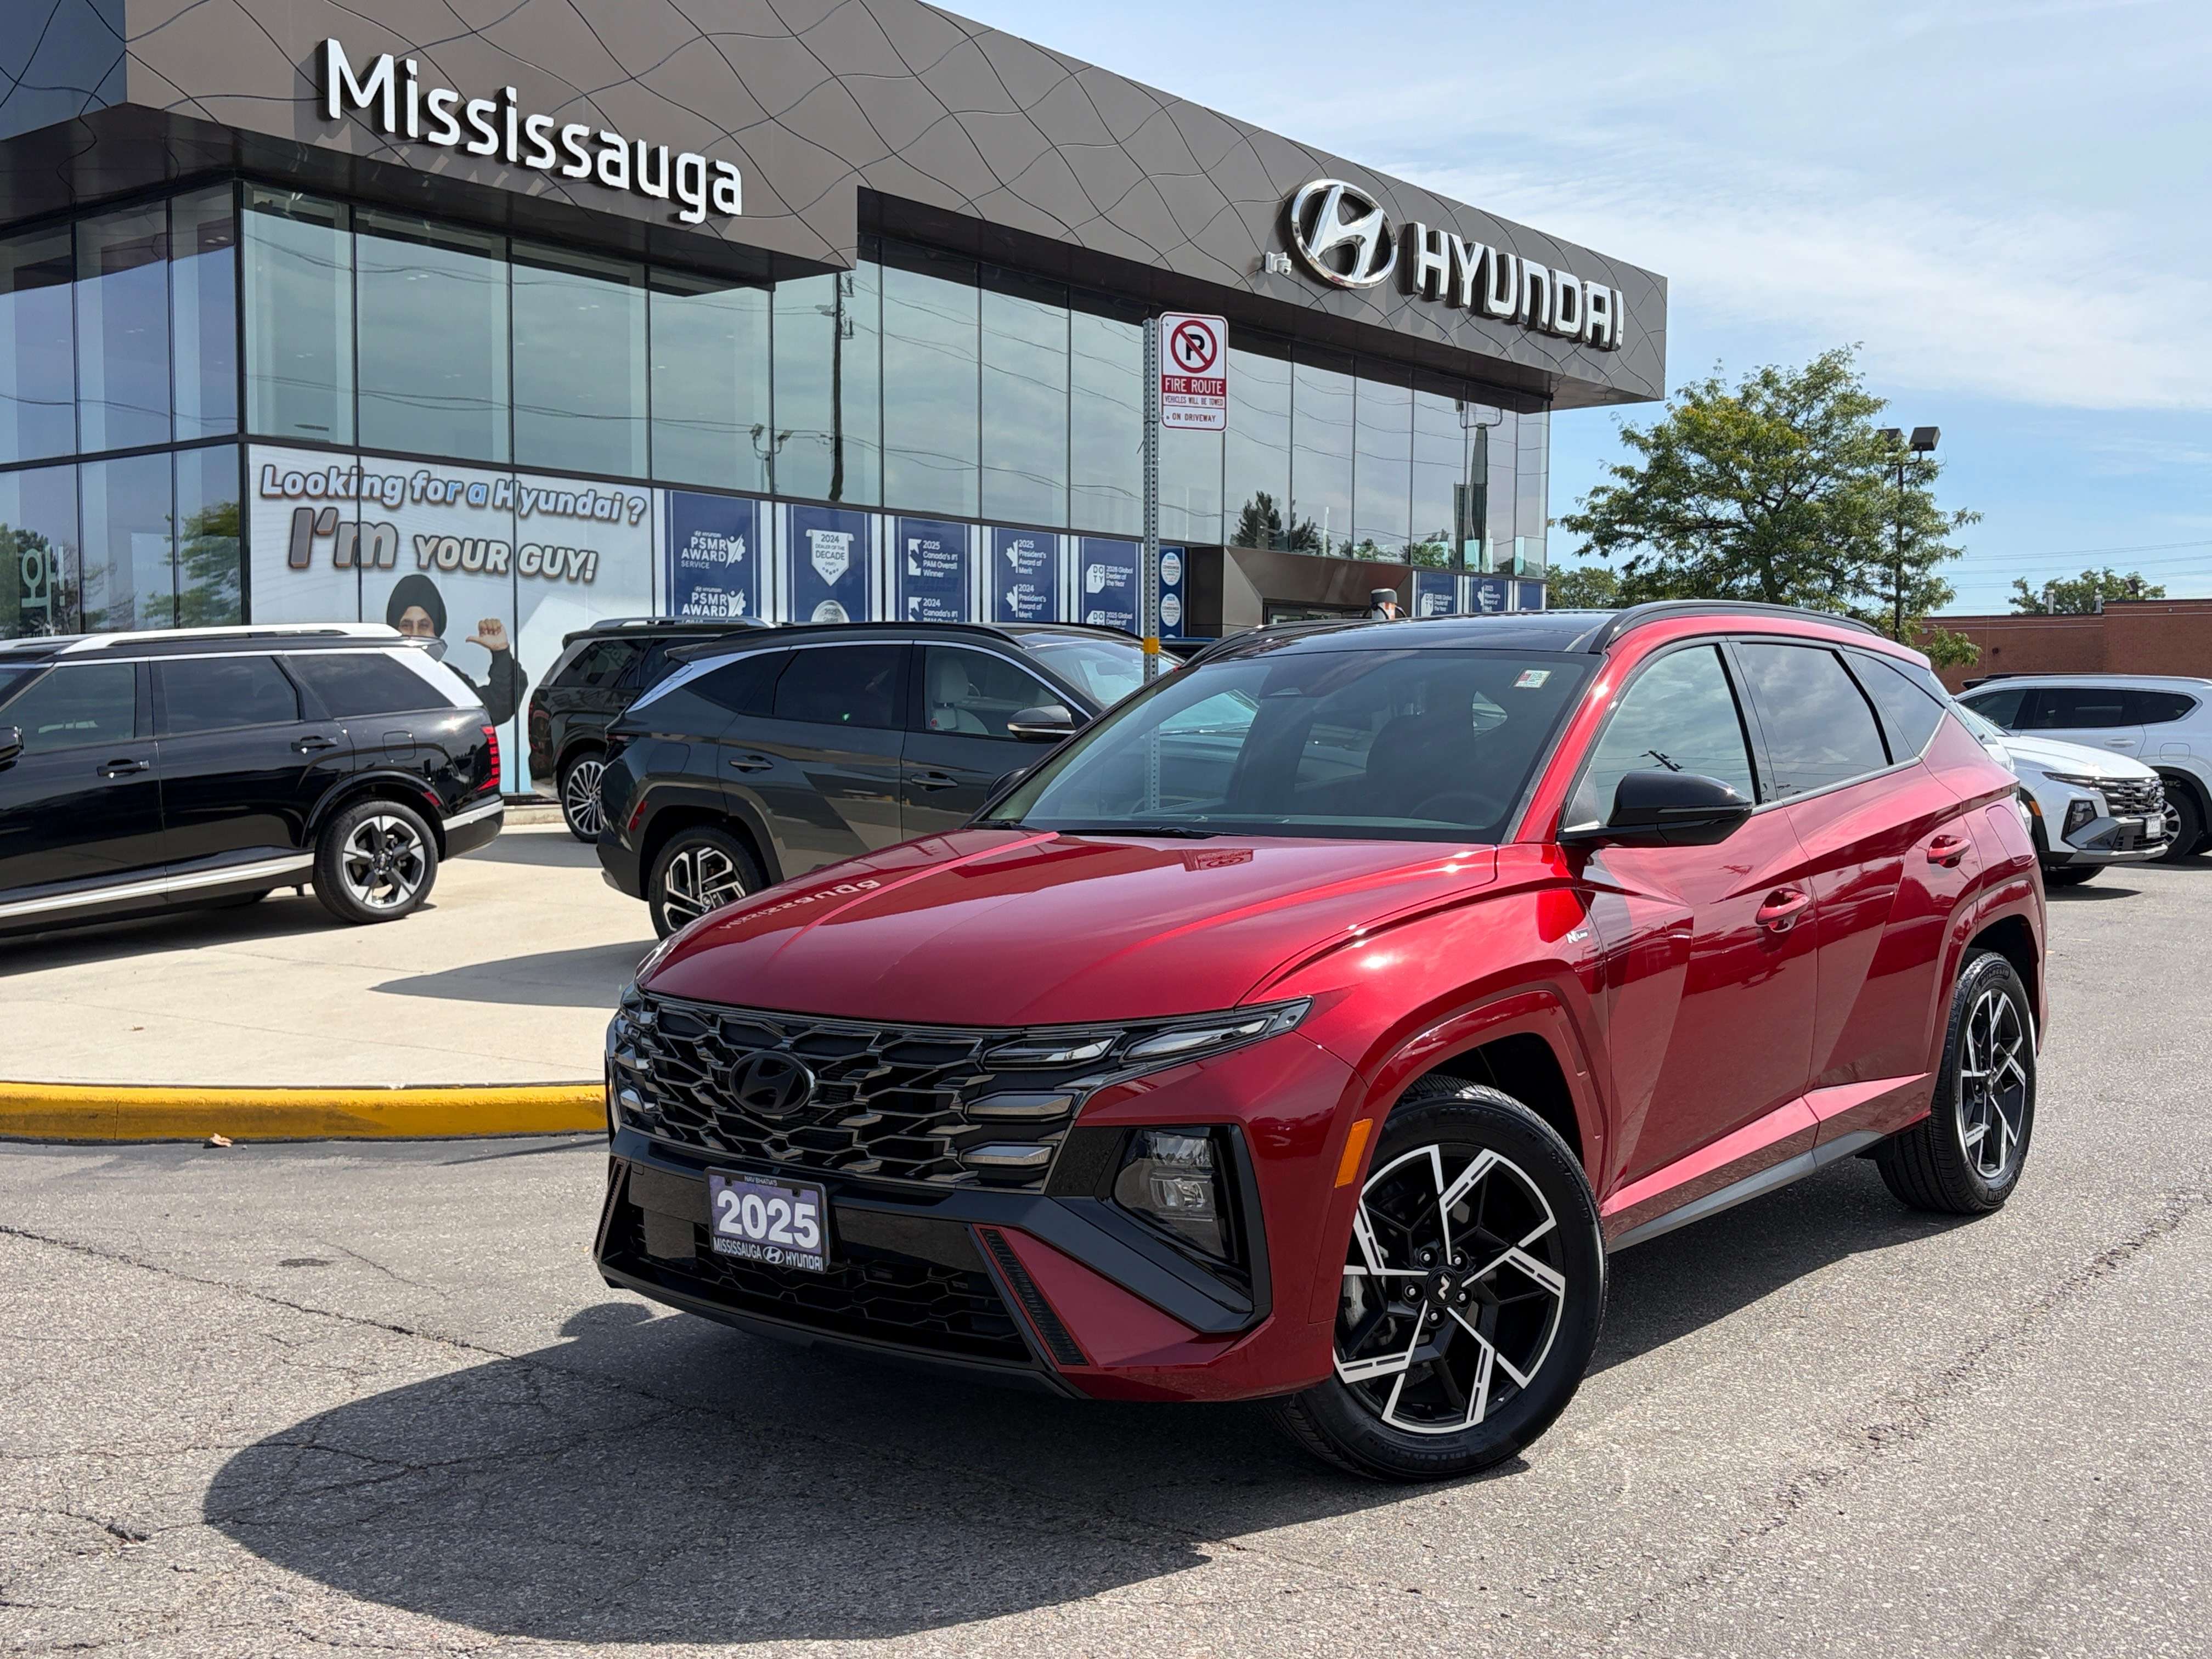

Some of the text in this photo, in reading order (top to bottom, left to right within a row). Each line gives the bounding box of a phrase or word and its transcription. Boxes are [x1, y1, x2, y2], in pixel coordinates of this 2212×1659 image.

[325, 37, 743, 224] Mississauga
[1412, 221, 1625, 352] HYUNDAI
[1165, 377, 1223, 394] FIRE ROUTE
[1165, 396, 1186, 404] VEHICLES
[1172, 413, 1216, 422] ON DRIVEWAY
[261, 464, 404, 509] Looking
[412, 470, 461, 505] for
[467, 481, 489, 506] a
[494, 479, 623, 521] Hyundai
[821, 534, 839, 543] 2024
[288, 507, 598, 583] I'm YOUR GUY!
[690, 537, 727, 551] PSMR
[923, 540, 940, 550] 2025
[1018, 539, 1035, 549] 2025
[681, 548, 726, 562] AWARD
[815, 550, 845, 560] DECADE
[923, 551, 950, 560] Canada's
[1019, 550, 1047, 559] President's
[681, 560, 710, 569] SERVICE
[923, 560, 957, 569] PAM Overall
[923, 569, 944, 578] Winner
[1018, 584, 1035, 592] 2024
[691, 592, 727, 606] PSMR
[923, 597, 941, 607] 2024
[1019, 594, 1047, 603] President's
[682, 603, 727, 617] AWARD
[1019, 602, 1036, 611] Award
[923, 608, 950, 618] Canada's
[717, 1189, 820, 1249] 2025
[713, 1237, 823, 1271] MISSISSAUGA HYUNDAI
